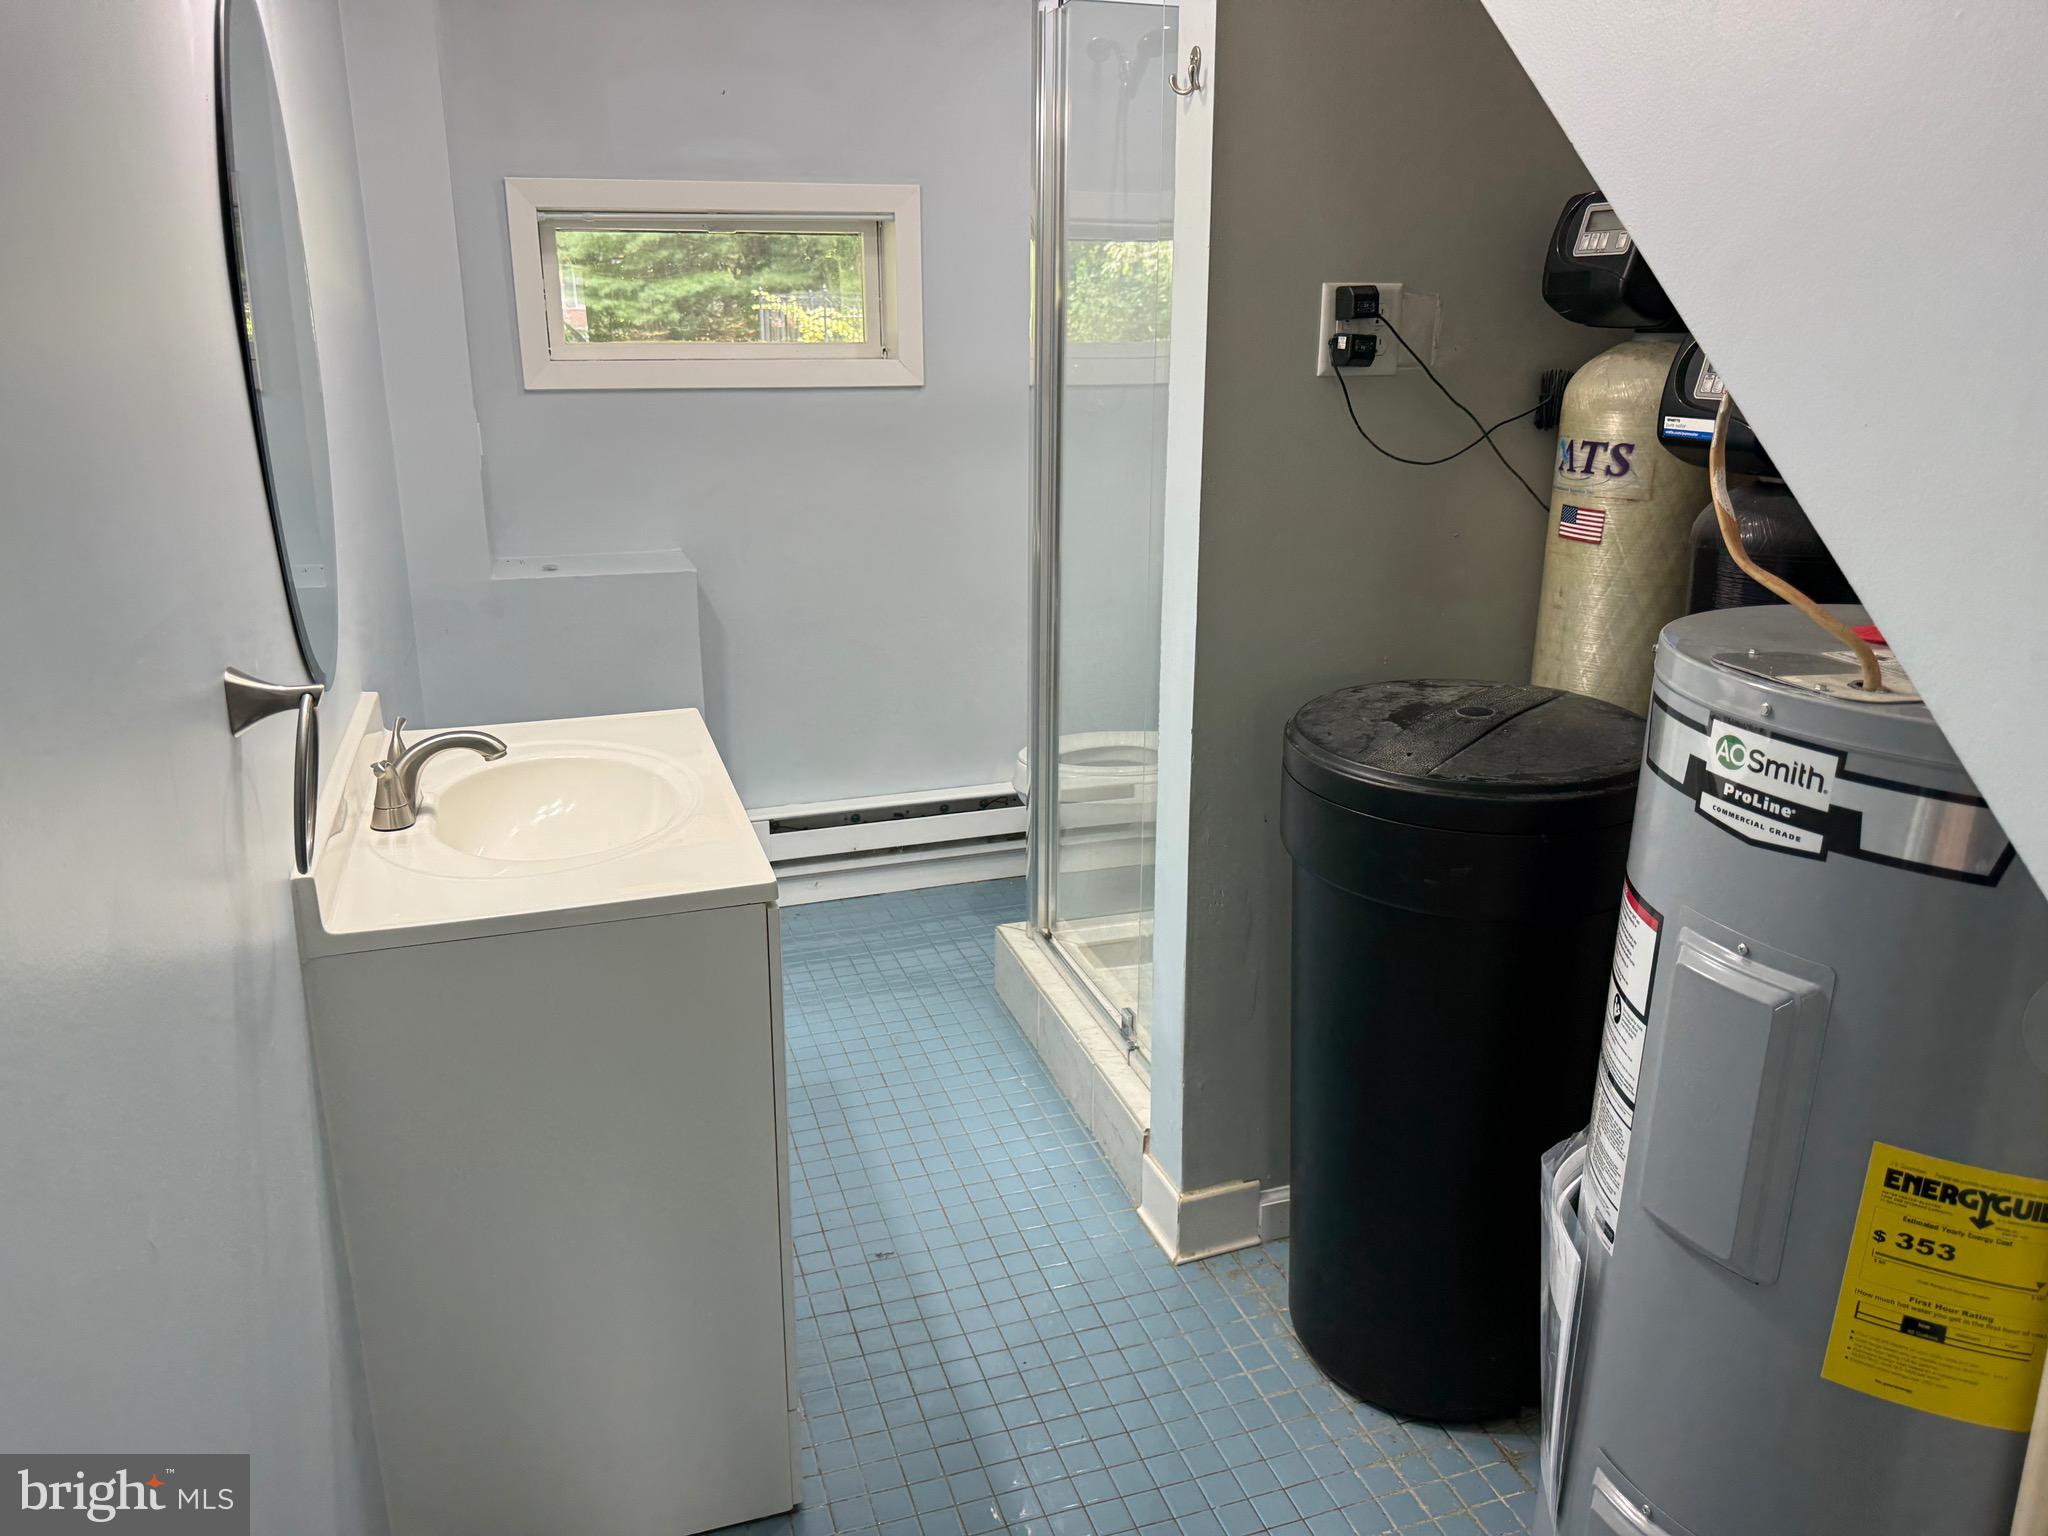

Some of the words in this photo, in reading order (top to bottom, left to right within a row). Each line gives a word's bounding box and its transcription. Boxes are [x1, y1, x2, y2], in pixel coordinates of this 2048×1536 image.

[1558, 440, 1635, 477] ATS
[1723, 782, 1793, 818] ProLine
[1712, 804, 1765, 831] COMMERCIAL
[1769, 826, 1802, 843] GRADE
[1872, 1229, 1887, 1244] $
[1894, 1232, 1957, 1261] 353
[1903, 1215, 1940, 1231] Estimated
[1942, 1226, 1966, 1239] Yearly
[1967, 1232, 1993, 1245] Energy
[1996, 1238, 2014, 1248] Cost
[1909, 1296, 1932, 1309] First
[1935, 1302, 1959, 1315] Hour
[1961, 1309, 1995, 1324] Rating
